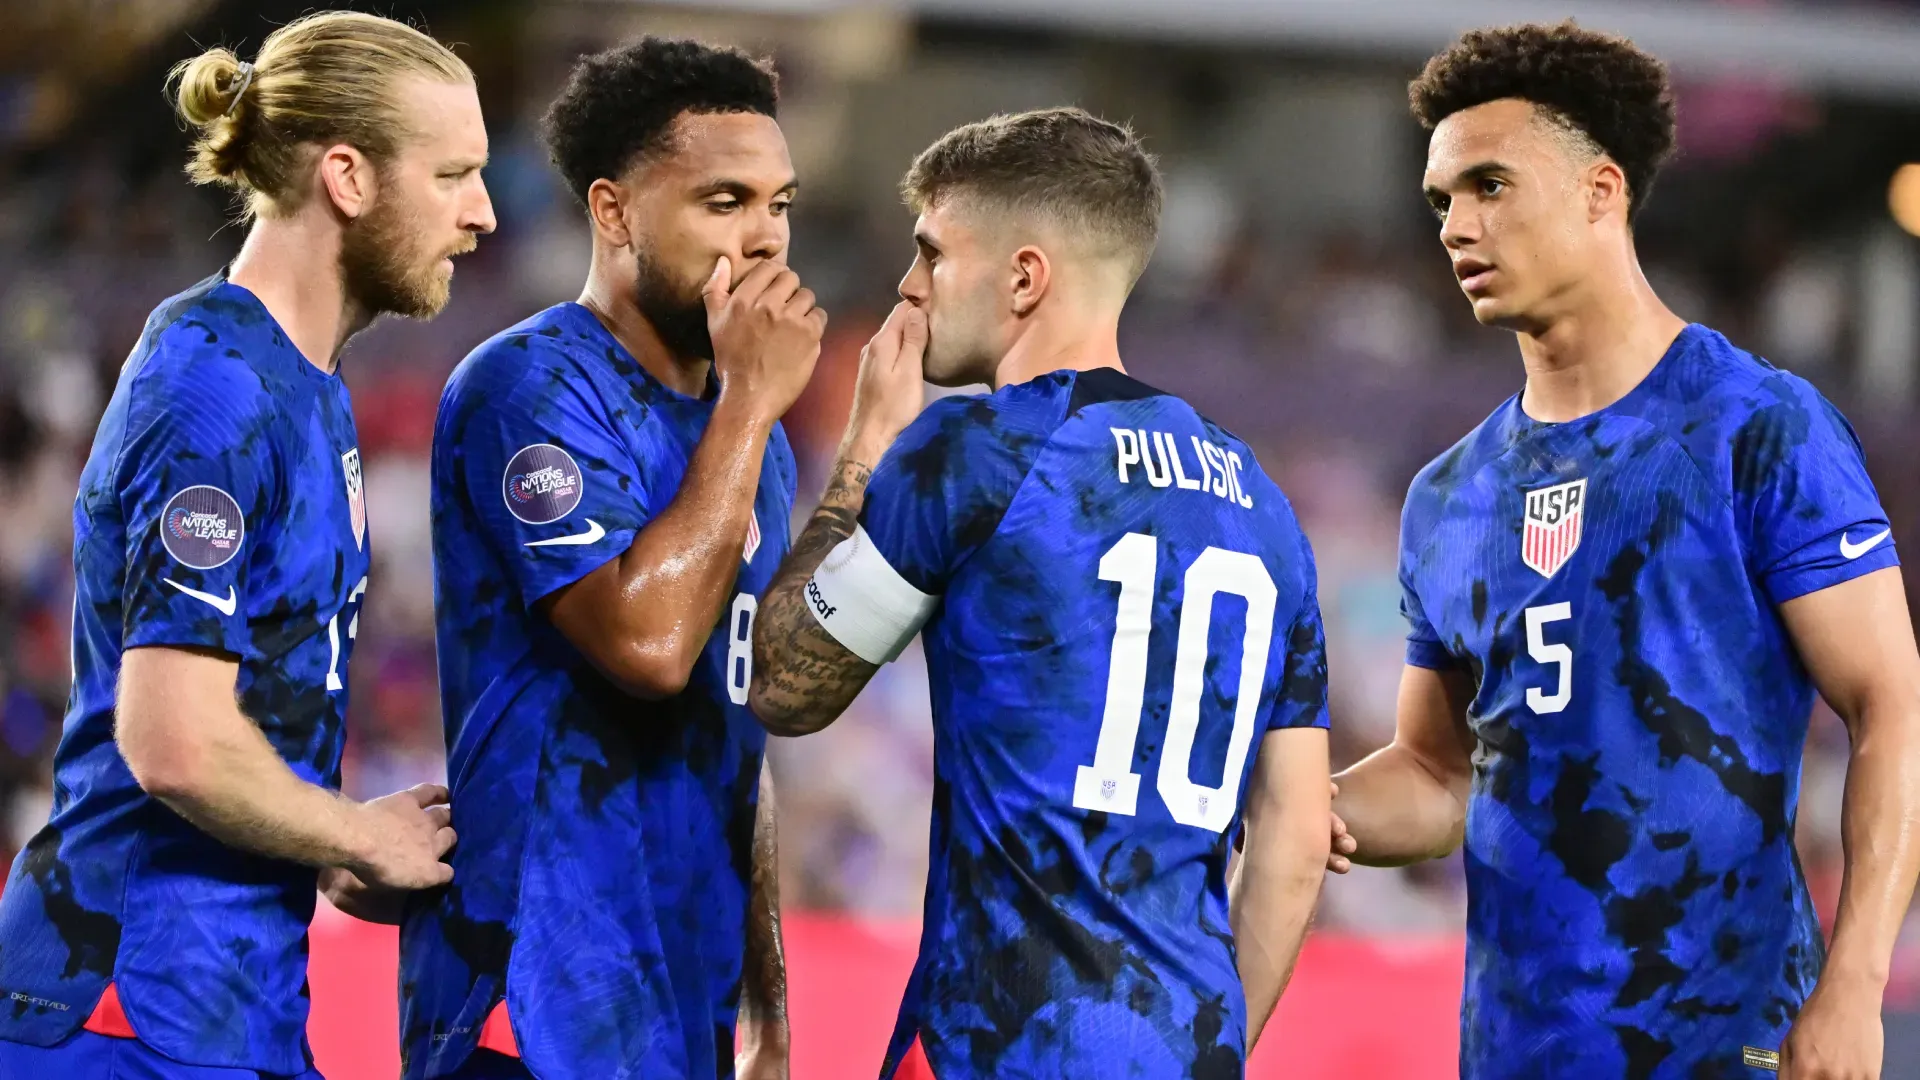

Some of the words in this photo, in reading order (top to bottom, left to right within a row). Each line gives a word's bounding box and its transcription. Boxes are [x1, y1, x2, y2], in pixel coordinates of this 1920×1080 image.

[521, 468, 563, 491] NATIONS
[1110, 426, 1253, 510] PULISIC
[536, 475, 576, 494] LEAGUE
[1529, 484, 1581, 524] USA
[181, 516, 227, 529] NATIONS
[195, 527, 237, 540] LEAGUE
[727, 592, 758, 706] 8
[1525, 601, 1572, 714] 5
[1072, 532, 1278, 833] 10
[1102, 780, 1116, 790] USA
